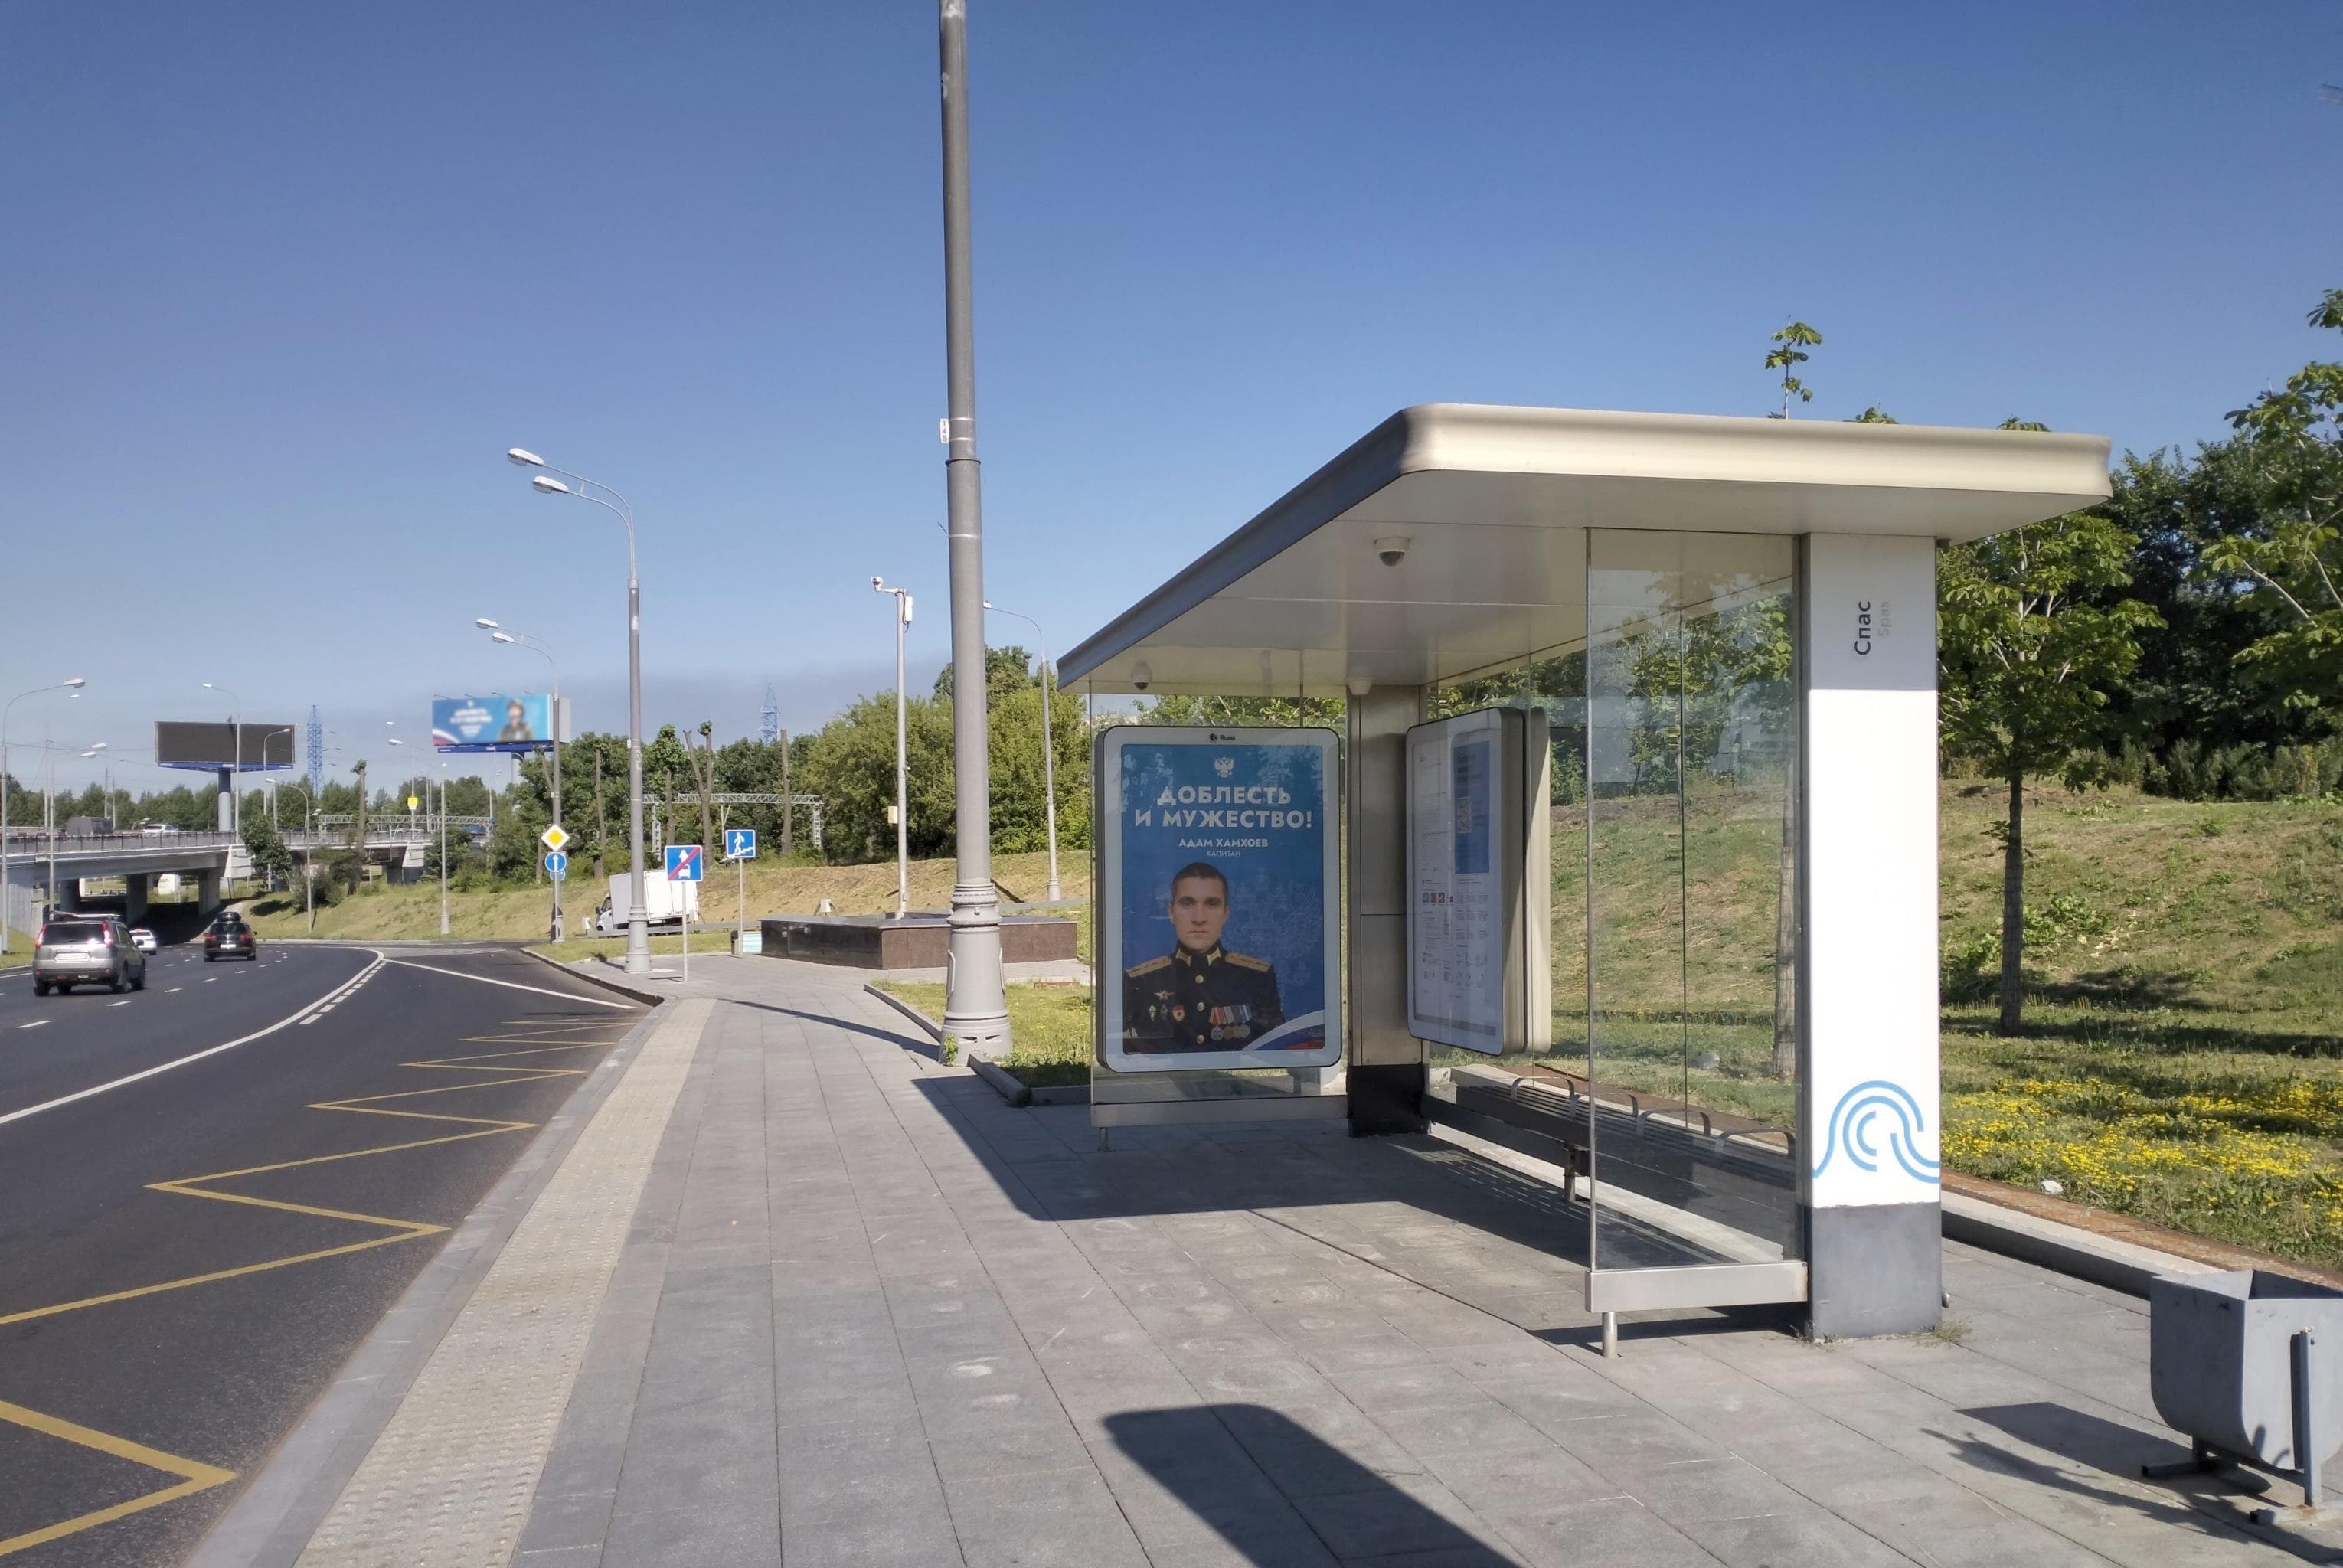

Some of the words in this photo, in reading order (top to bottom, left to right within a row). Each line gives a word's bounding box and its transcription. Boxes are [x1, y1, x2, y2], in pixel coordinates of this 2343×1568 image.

[1854, 601, 1871, 655] Спас
[1877, 601, 1891, 637] Spas
[1157, 786, 1291, 805] ДОБЛЕСТЬ
[1135, 808, 1151, 827] И
[1162, 809, 1312, 828] МУЖЕСТВО!
[1179, 838, 1213, 848] АДАМ
[1216, 838, 1268, 848] ХАМХОЕВ
